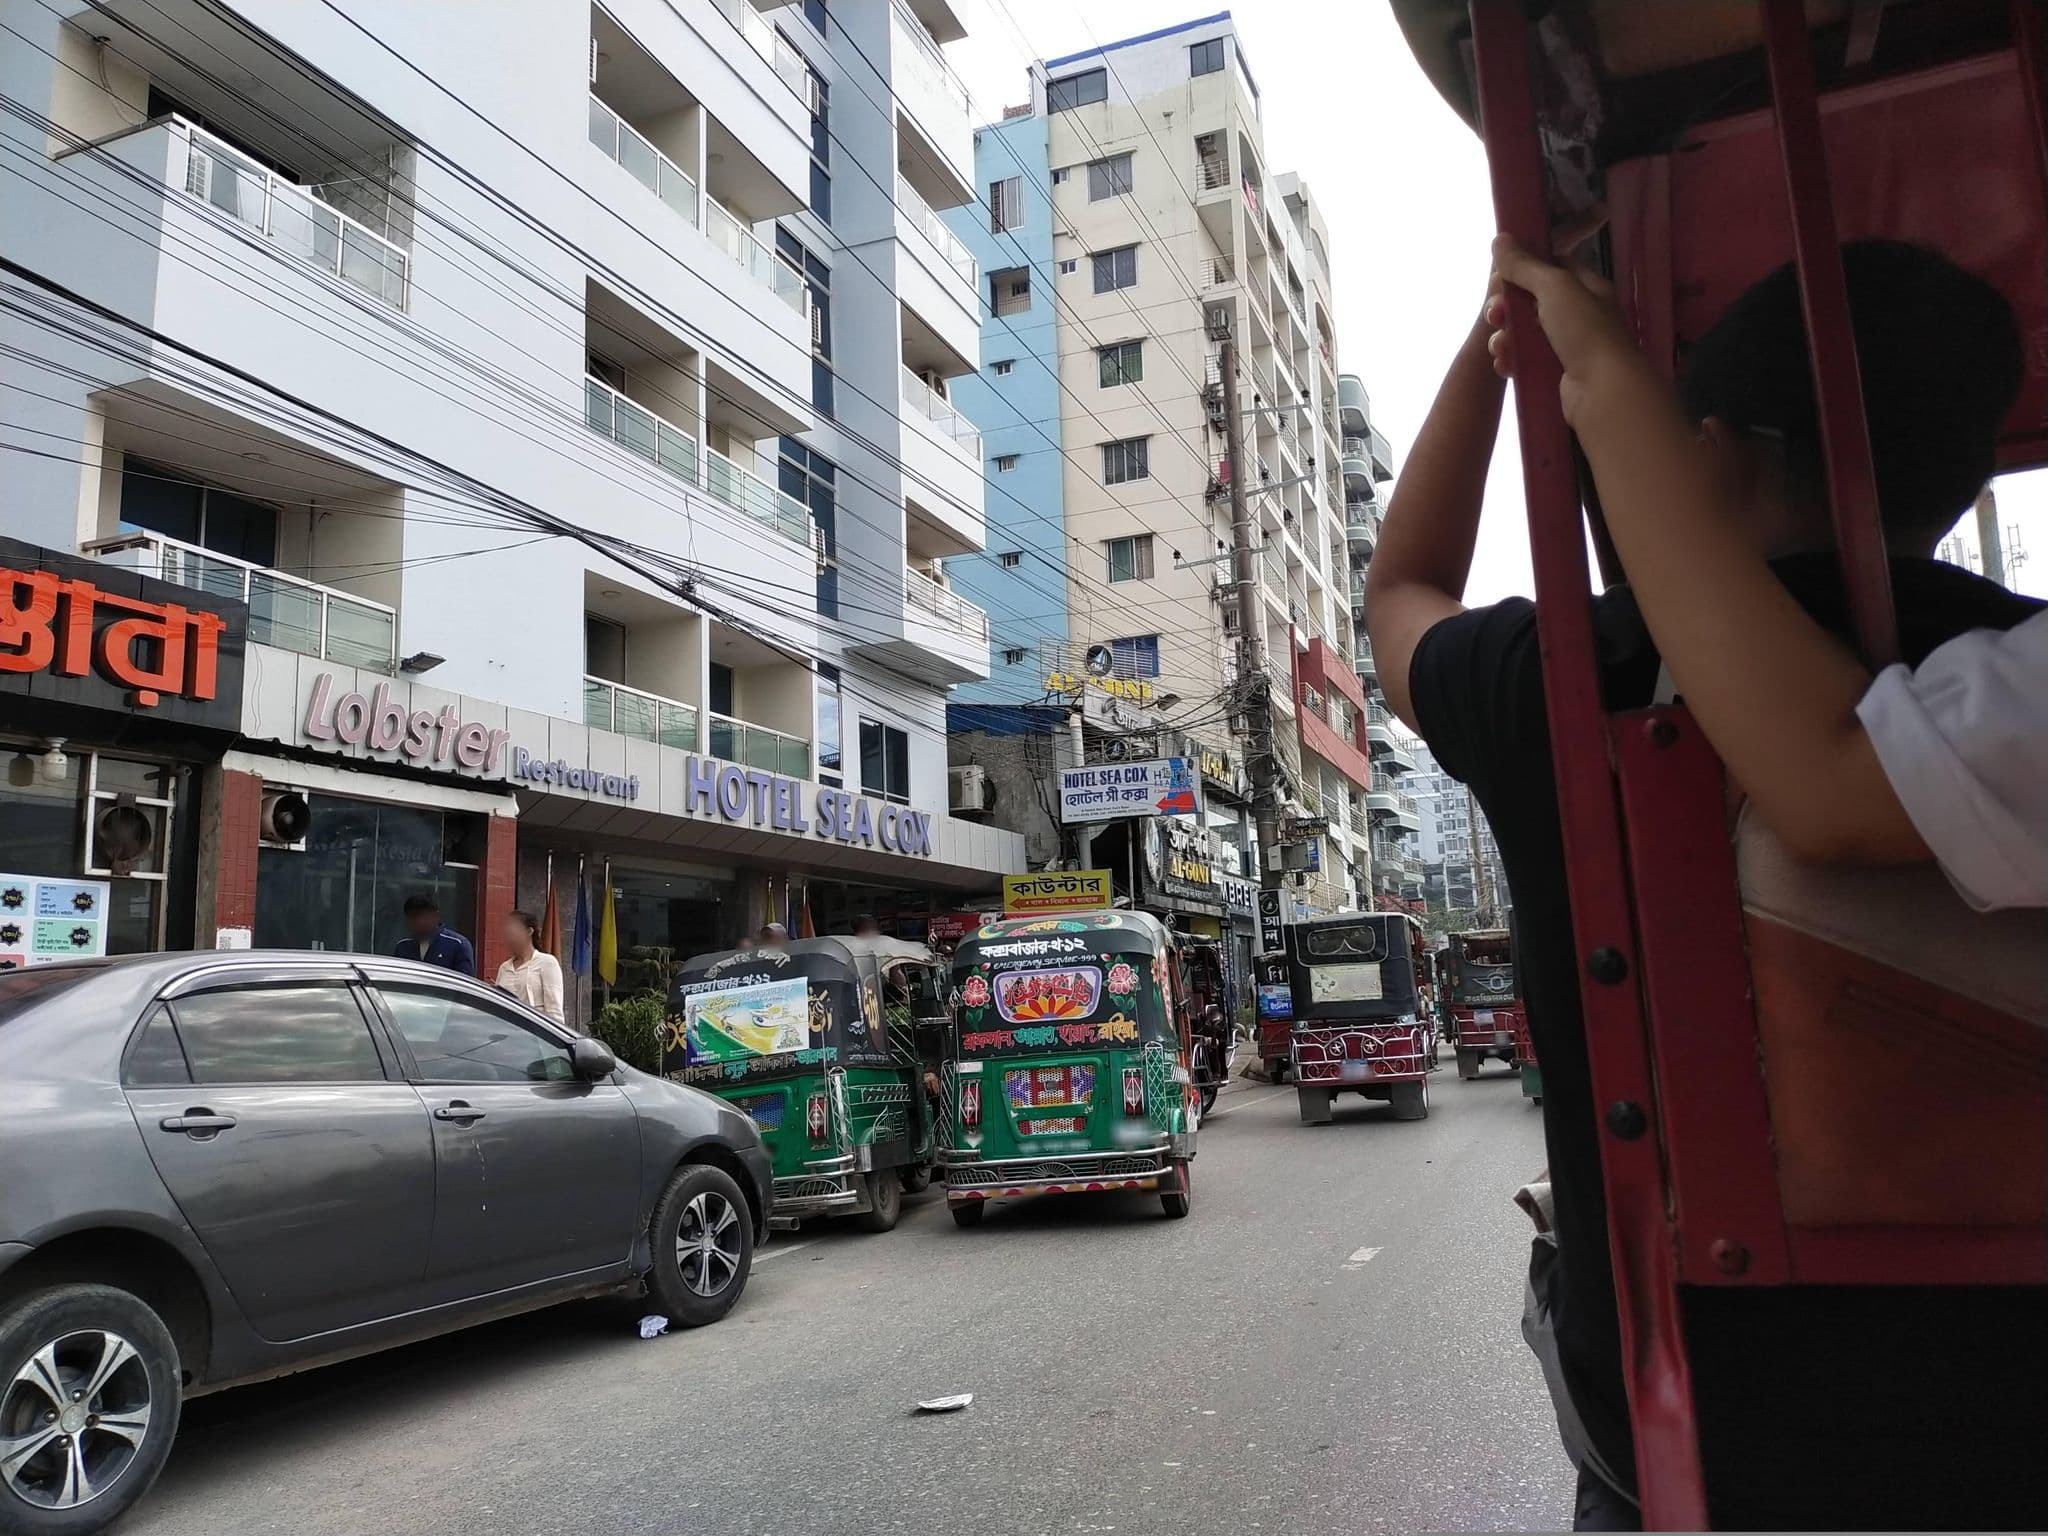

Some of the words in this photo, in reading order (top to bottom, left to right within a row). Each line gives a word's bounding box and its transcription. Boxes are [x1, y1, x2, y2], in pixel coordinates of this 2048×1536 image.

[302, 671, 510, 772] Lobster
[512, 745, 642, 801] Restaurant
[1063, 771, 1098, 789] HOTEL
[1099, 768, 1122, 785] SEA
[1123, 766, 1149, 783] COX
[685, 753, 810, 833] HOTEL
[815, 788, 875, 847] SEA
[879, 804, 933, 857] COX
[1065, 789, 1104, 808] হোটেল
[1171, 855, 1210, 884] AL-GONI
[1008, 874, 1104, 896] কাউন্টার
